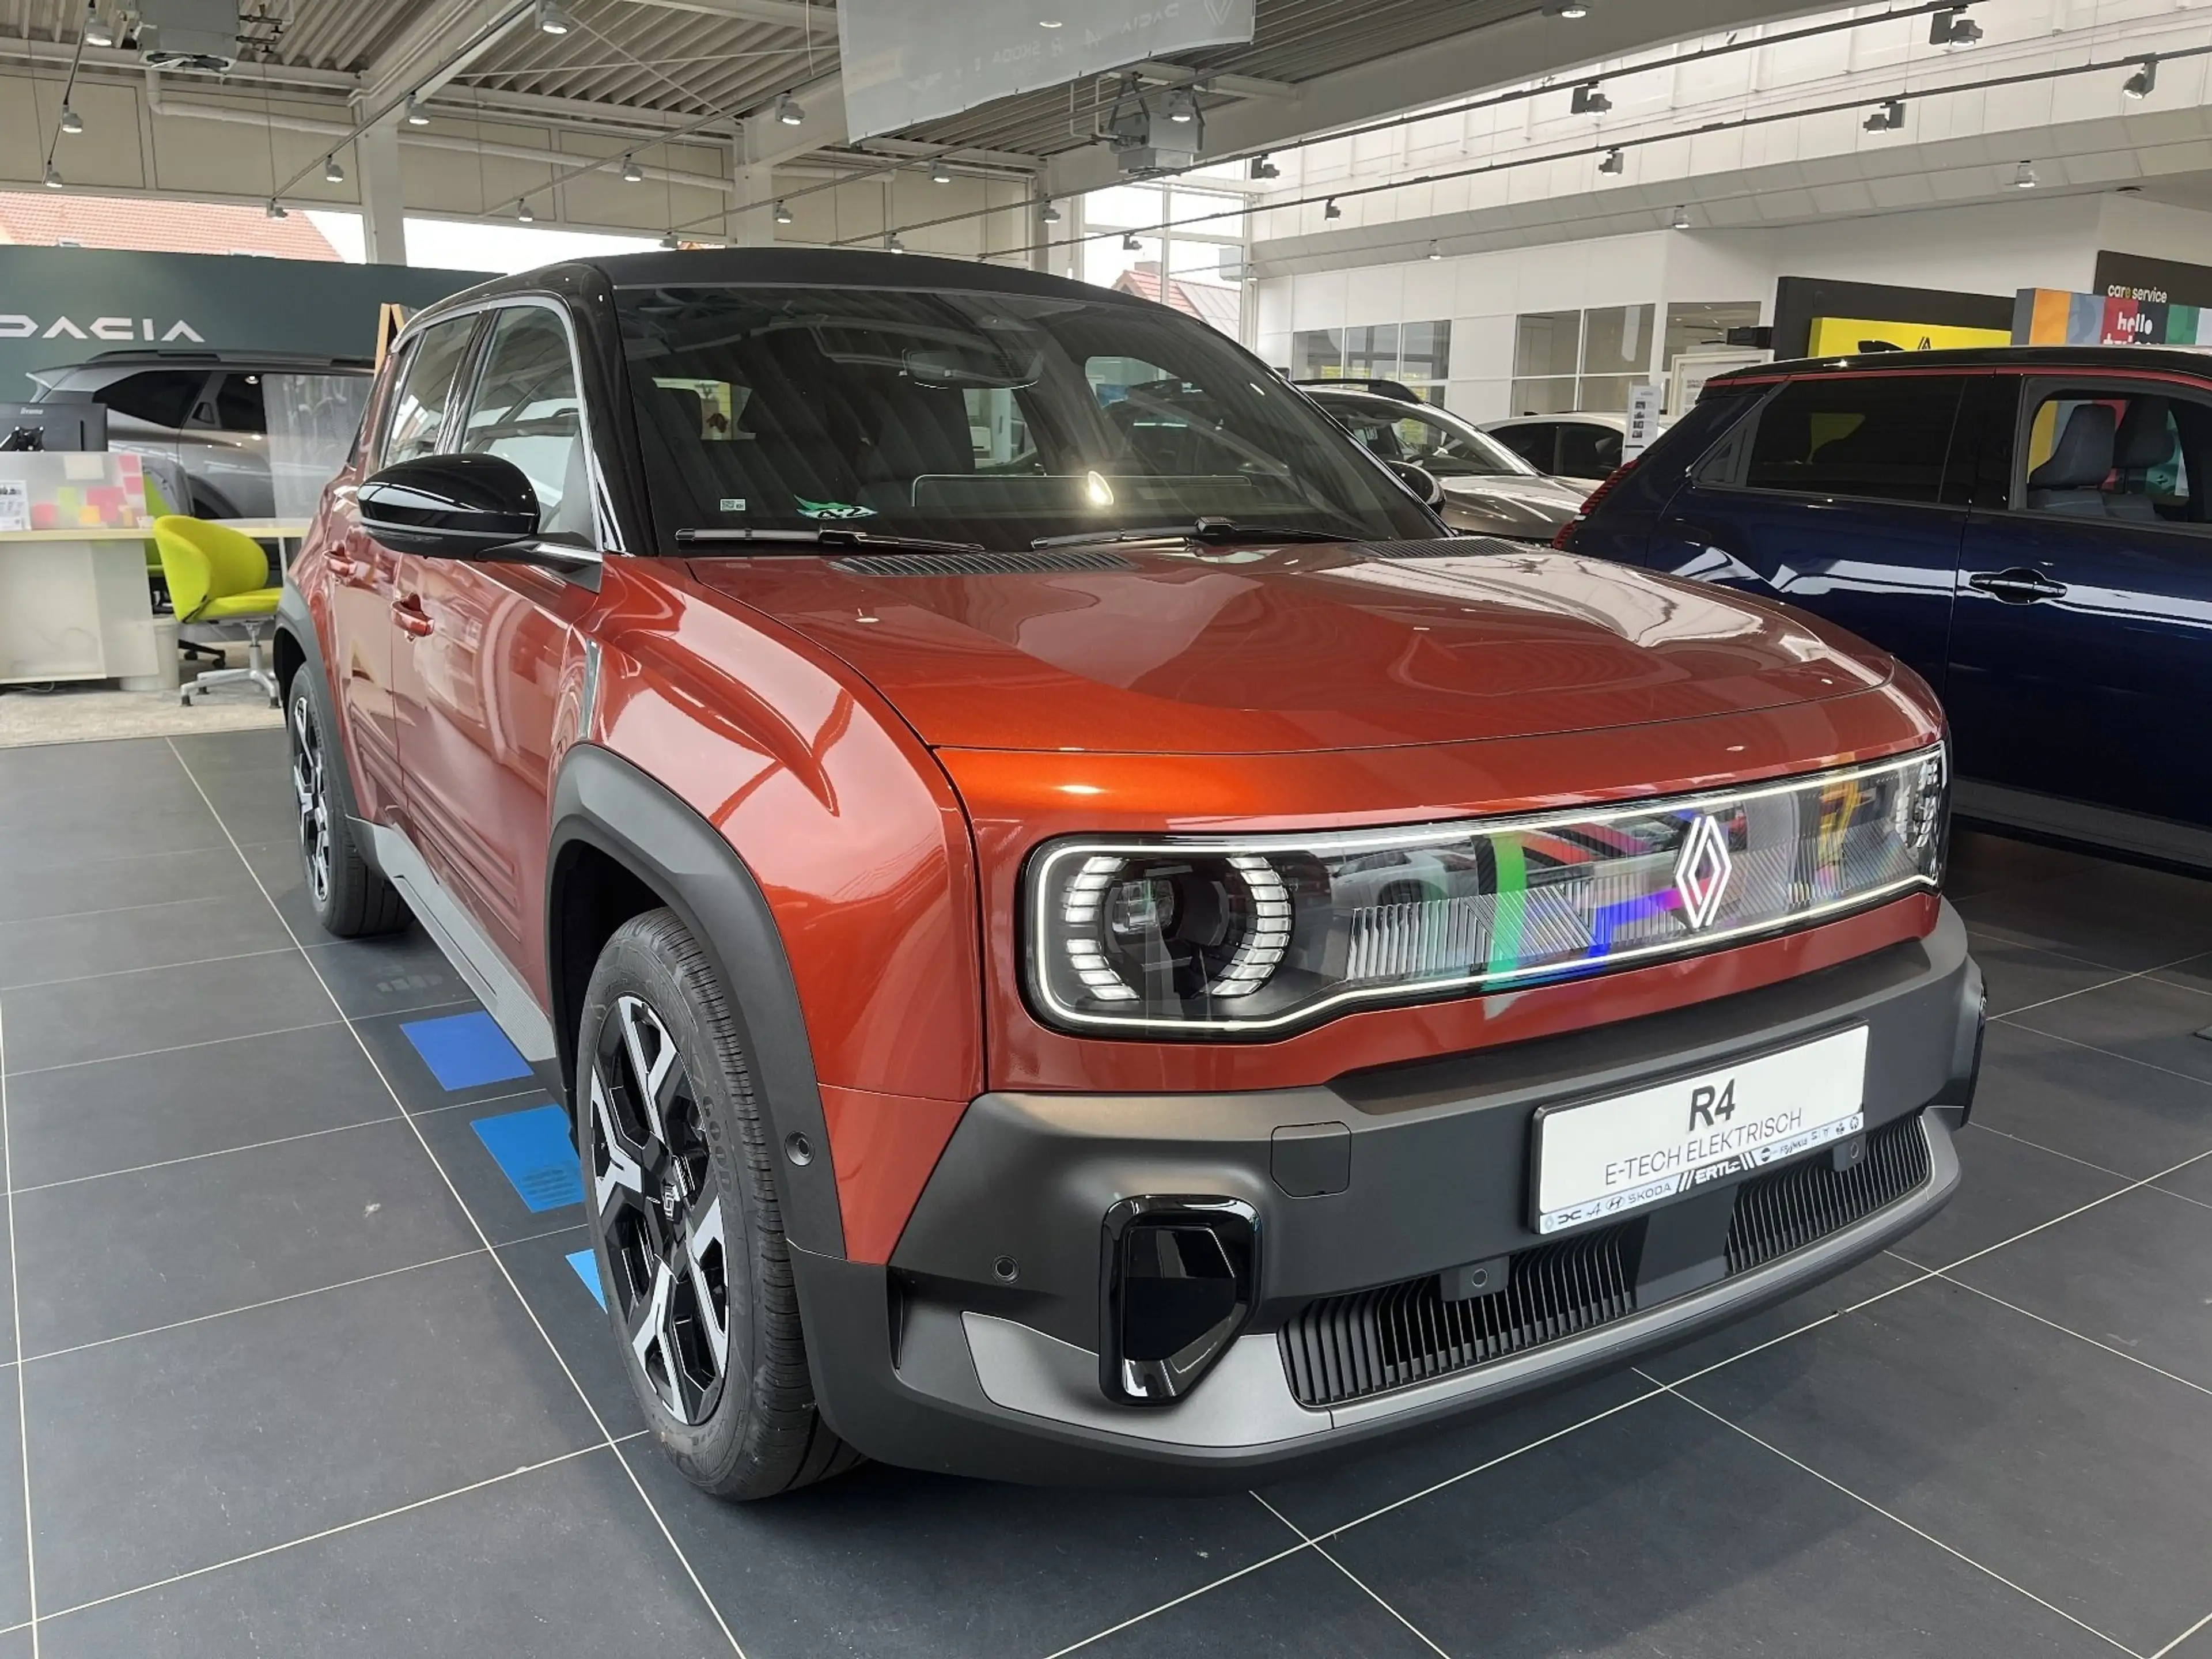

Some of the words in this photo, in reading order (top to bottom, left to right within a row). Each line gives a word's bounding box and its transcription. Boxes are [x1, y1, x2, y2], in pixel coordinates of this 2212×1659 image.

[2108, 285, 2131, 299] care
[2132, 287, 2167, 302] service
[0, 315, 205, 342] DACIA
[2117, 312, 2153, 334] hello
[1688, 1079, 1736, 1131] R4
[1605, 1144, 1680, 1185] E-TECH
[1687, 1108, 1802, 1162] ELEKTRISCH
